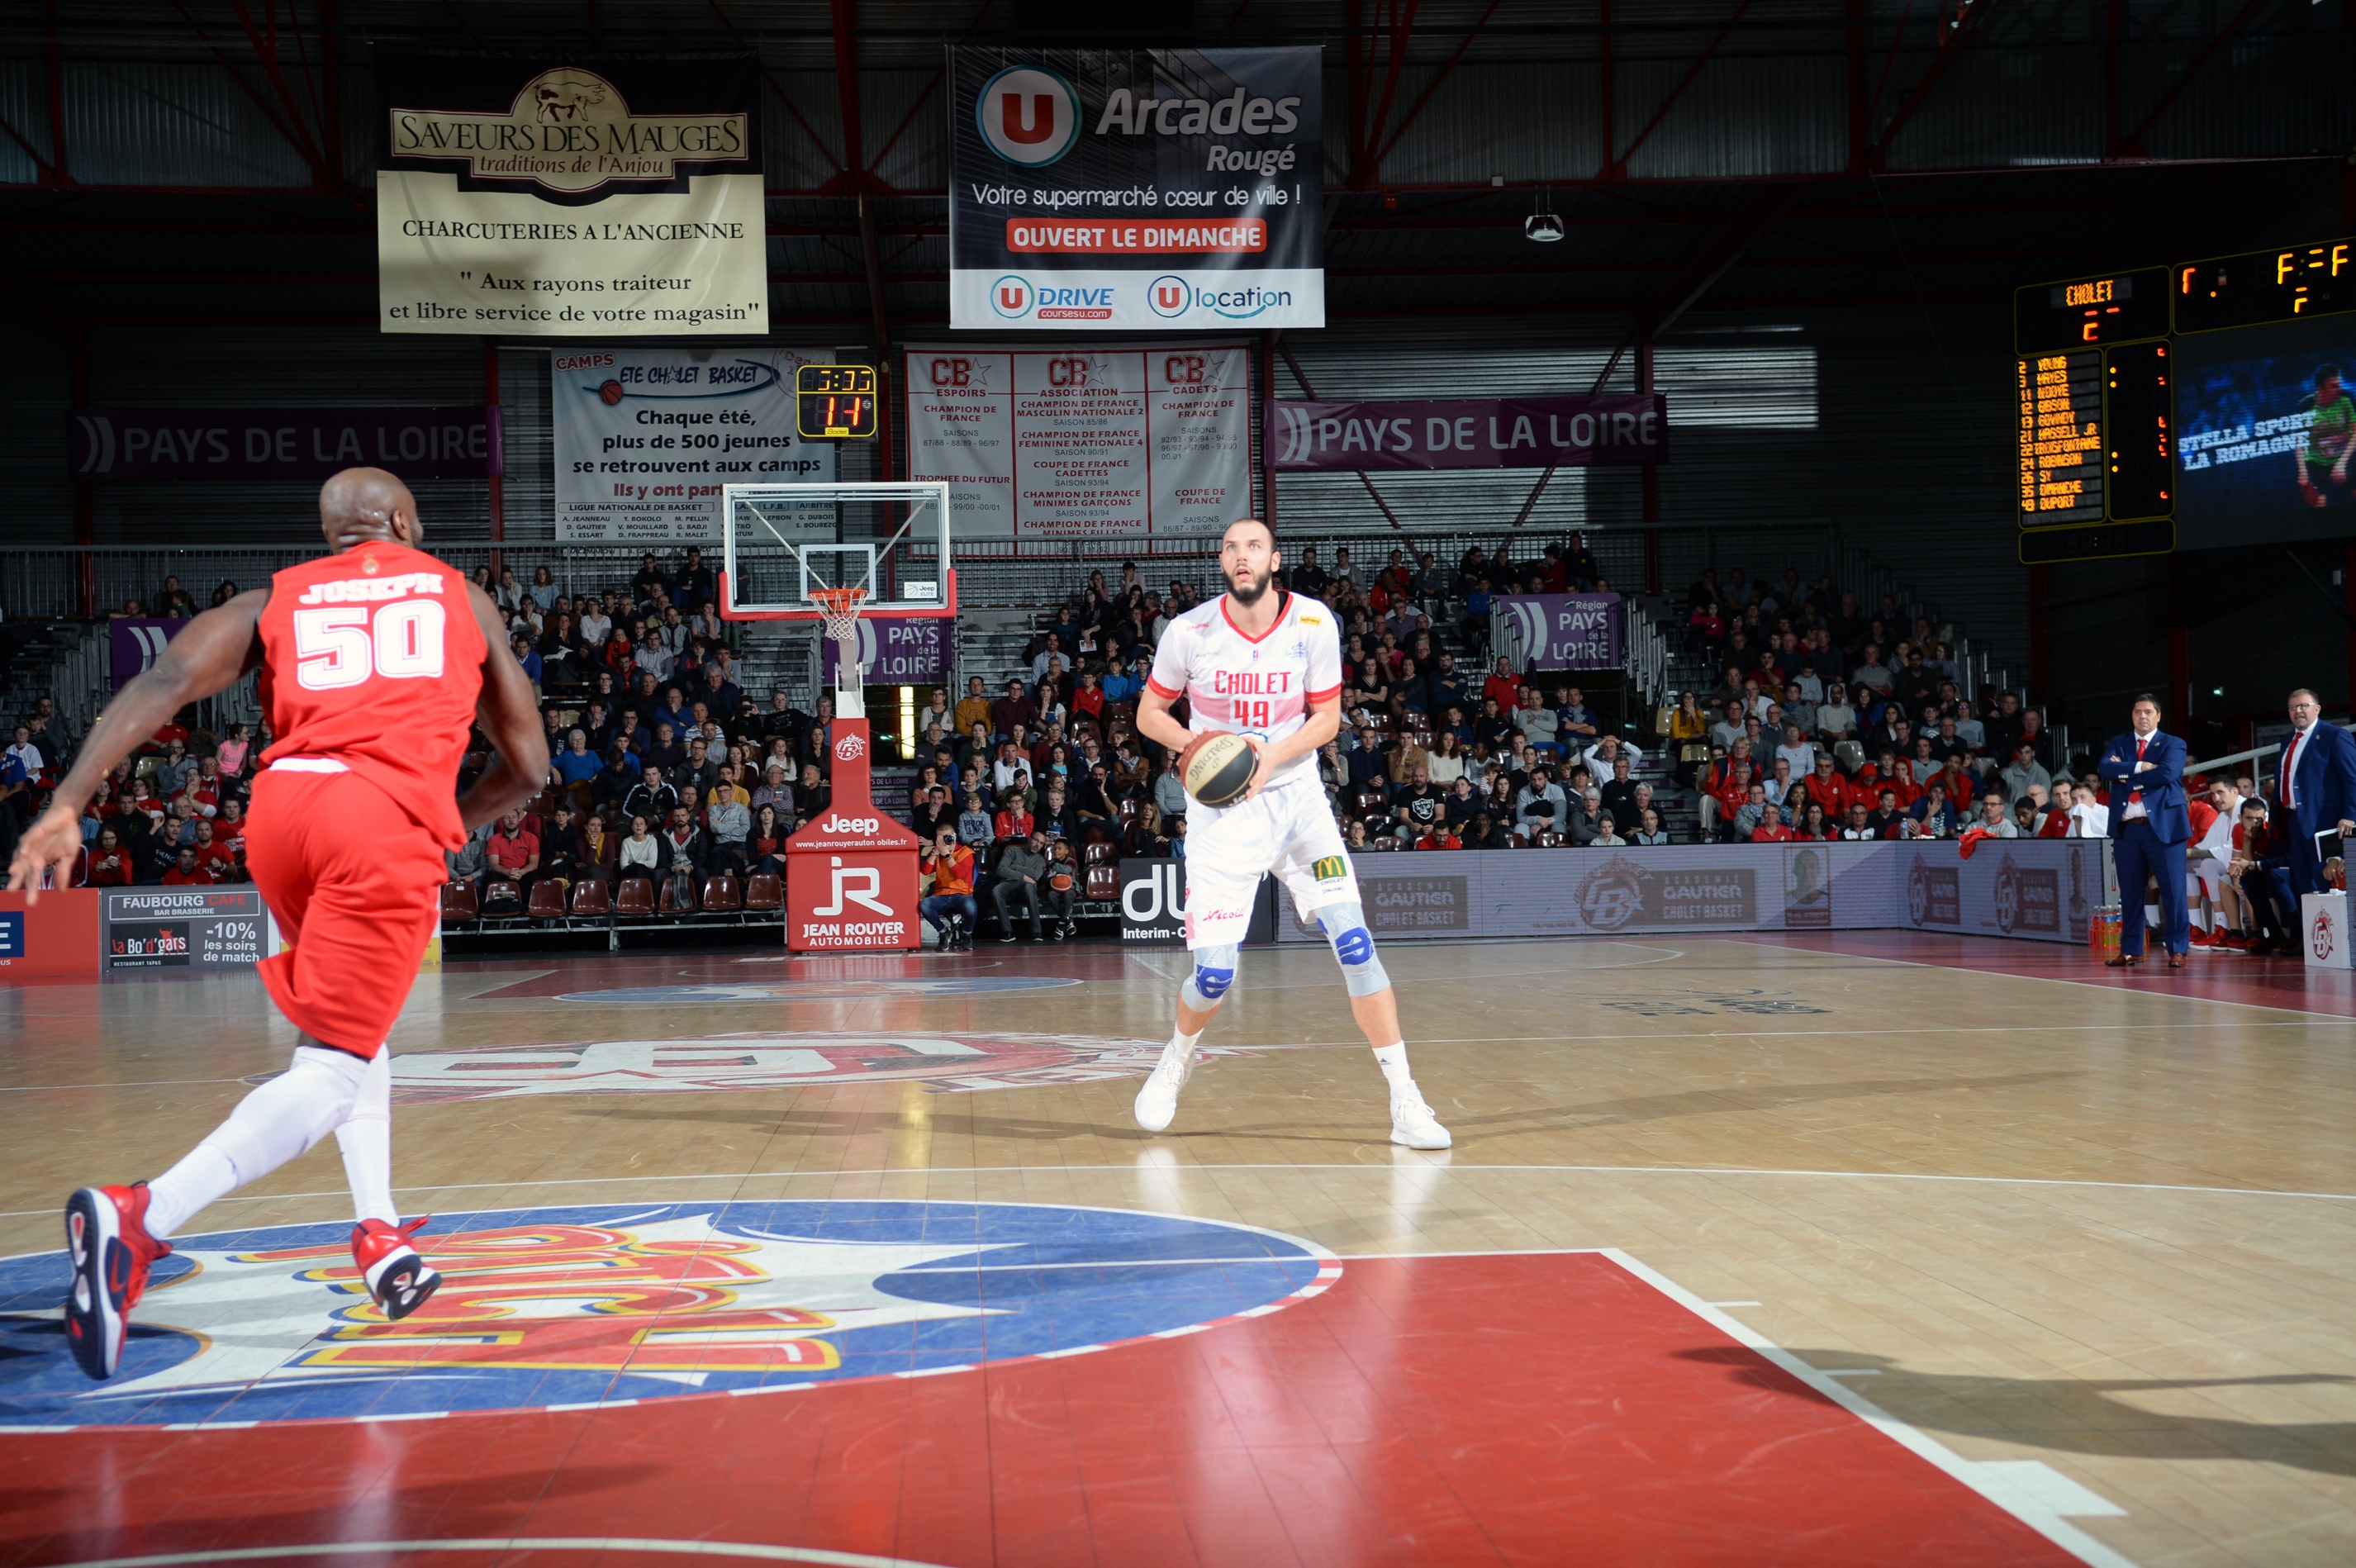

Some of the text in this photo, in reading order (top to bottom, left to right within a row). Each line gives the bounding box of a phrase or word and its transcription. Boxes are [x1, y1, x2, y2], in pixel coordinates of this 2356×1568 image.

[1002, 93, 1054, 145] U
[1095, 88, 1301, 135] Arcades
[399, 116, 739, 154] SAVEURS DES MAUGES
[481, 154, 663, 177] traditions de l'Anjou
[1206, 144, 1295, 176] Rougé
[971, 183, 1288, 210] Votre supermarché cœur de ville
[402, 221, 743, 240] CHARCUTERIES A L'ANCIENNE
[1014, 227, 1261, 247] OUVERT LE DIMANCHE
[480, 273, 691, 297] Aux rayons traiteur
[2066, 281, 2113, 306] CHOLET
[1001, 288, 1114, 309] U DRIVE
[1158, 287, 1290, 307] U location
[389, 305, 410, 319] et
[416, 303, 468, 320] libre
[475, 304, 552, 321] service
[559, 305, 585, 321] de
[591, 305, 646, 321] votre
[1041, 310, 1107, 318] coursesu.com
[555, 353, 615, 371] CAMPS
[620, 367, 643, 382] ETE
[709, 367, 758, 384] BASKET
[1173, 386, 1218, 394] CADETS
[1162, 402, 1218, 410] CHAMPION
[636, 410, 756, 428] Chaque été,
[1319, 411, 1657, 451] PAYS DE LA LOIRE
[2178, 410, 2316, 452] STELLA SPORT
[124, 424, 487, 463] PAYS DE LA LOIRE
[603, 435, 791, 453] plus de 500 jeunes
[2183, 430, 2311, 471] LA ROMAGNE
[573, 460, 820, 475] se retrouvent aux camps
[614, 483, 633, 496] Ils
[638, 487, 648, 500] y
[653, 484, 683, 496] ont
[1081, 499, 1131, 507] GARÇONS
[299, 573, 443, 604] JOSEPH
[1576, 601, 1608, 611] Région
[1560, 612, 1608, 630] PAYS
[294, 599, 445, 690] 50
[889, 627, 938, 644] PAYS
[931, 645, 938, 653] la
[1553, 642, 1608, 660] LOIRE
[883, 657, 938, 674] LOIRE
[1214, 671, 1291, 695] CHOLET
[1234, 701, 1268, 728] 49
[1190, 737, 1233, 782] SPALDING
[822, 814, 878, 836] Jeep
[123, 896, 204, 909] FAUBOURG
[207, 922, 256, 939] -10%
[804, 922, 904, 938] JEAN ROUYER
[205, 940, 256, 950] les soirs
[810, 935, 899, 946] AUTOMOBILES
[203, 951, 259, 962] de match
